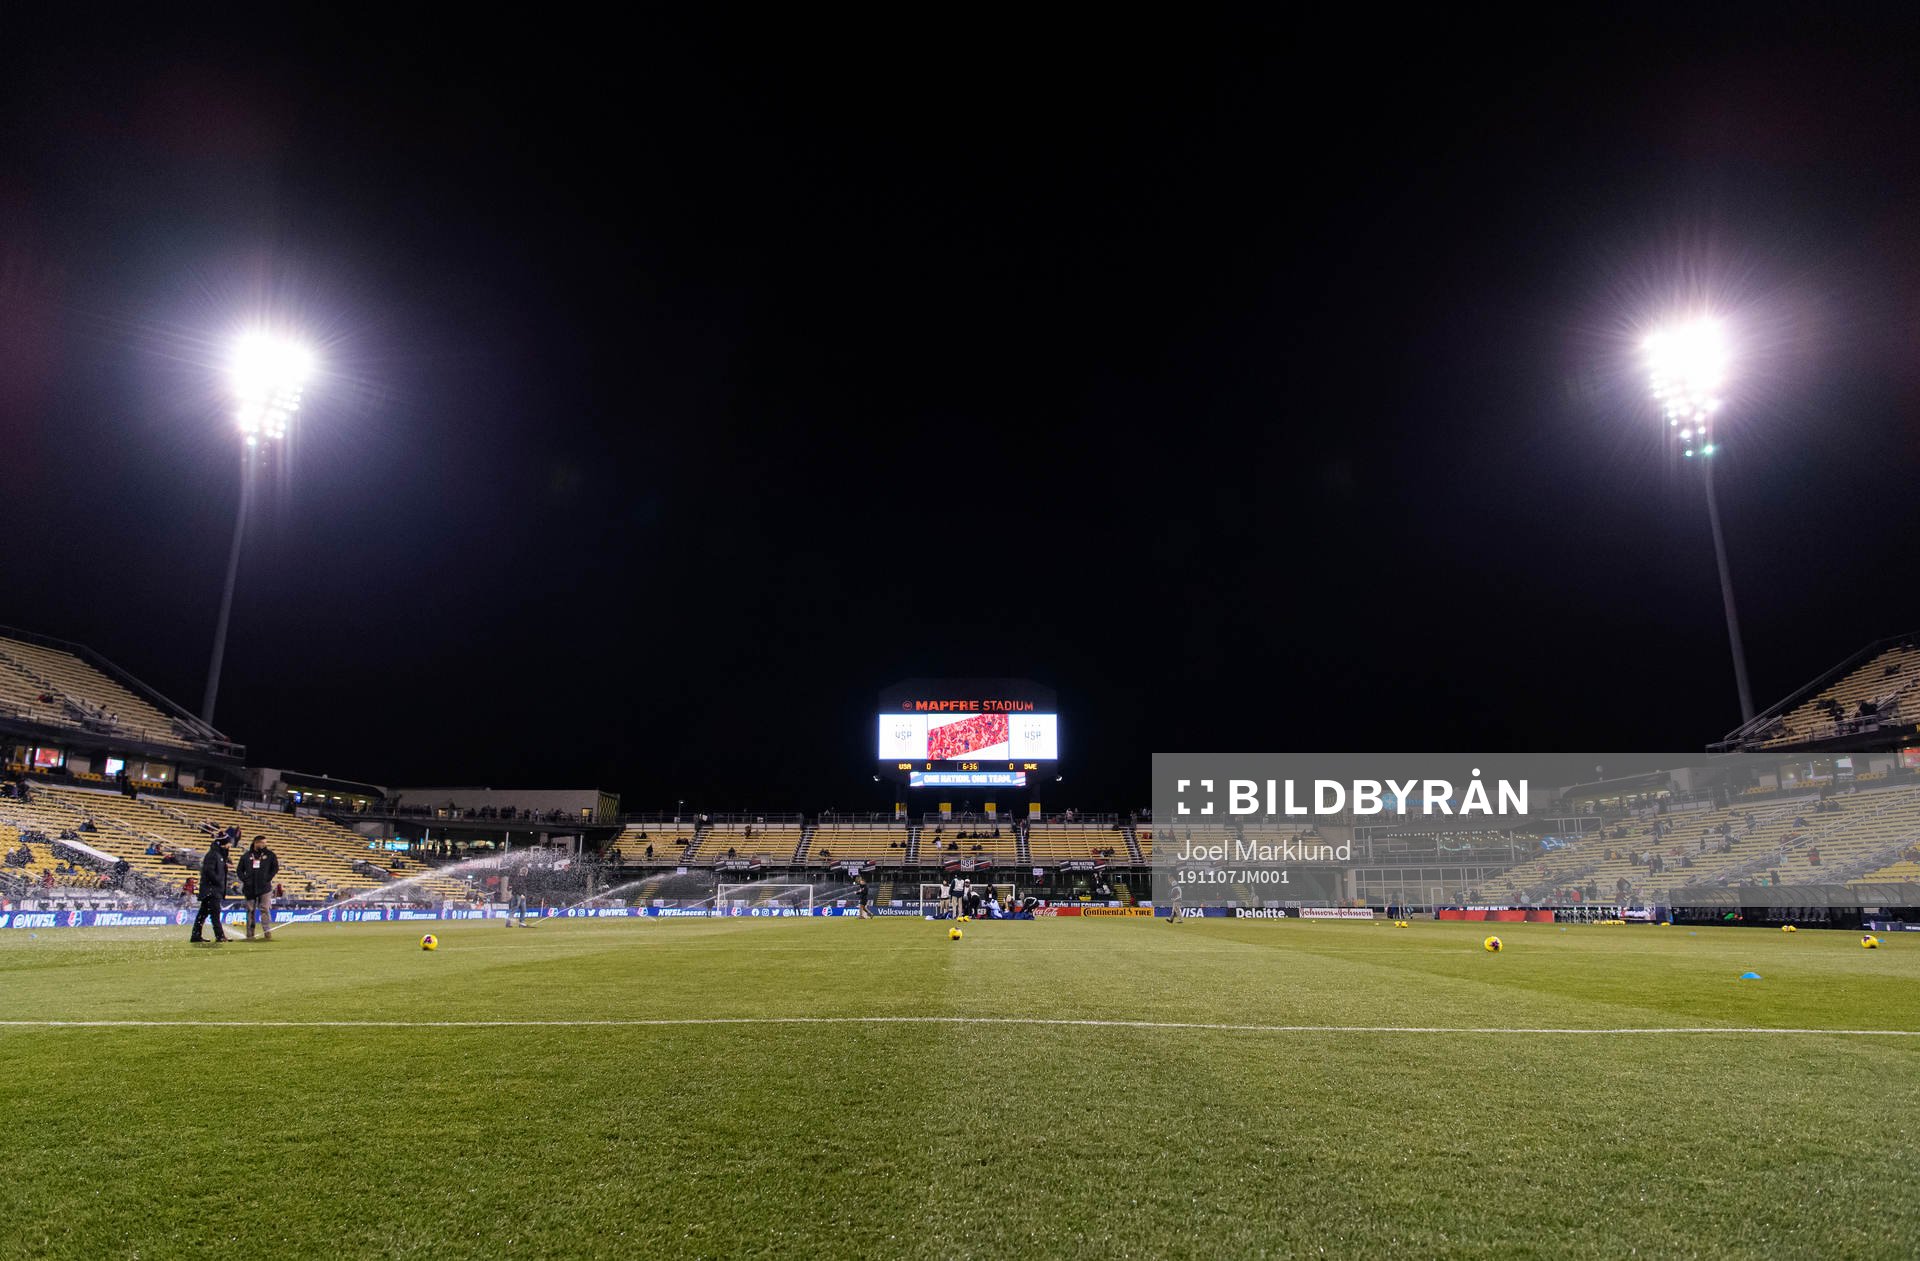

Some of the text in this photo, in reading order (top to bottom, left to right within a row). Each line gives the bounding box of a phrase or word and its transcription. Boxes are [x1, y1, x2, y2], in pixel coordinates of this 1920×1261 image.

[916, 701, 1033, 711] MAPFRE STADIUM
[598, 909, 628, 917] @NWSL
[1083, 908, 1151, 917] Continental TIRE
[1180, 908, 1204, 918] VISA
[13, 914, 56, 928] @NWSL
[94, 913, 167, 926] NWSLsoccer.com
